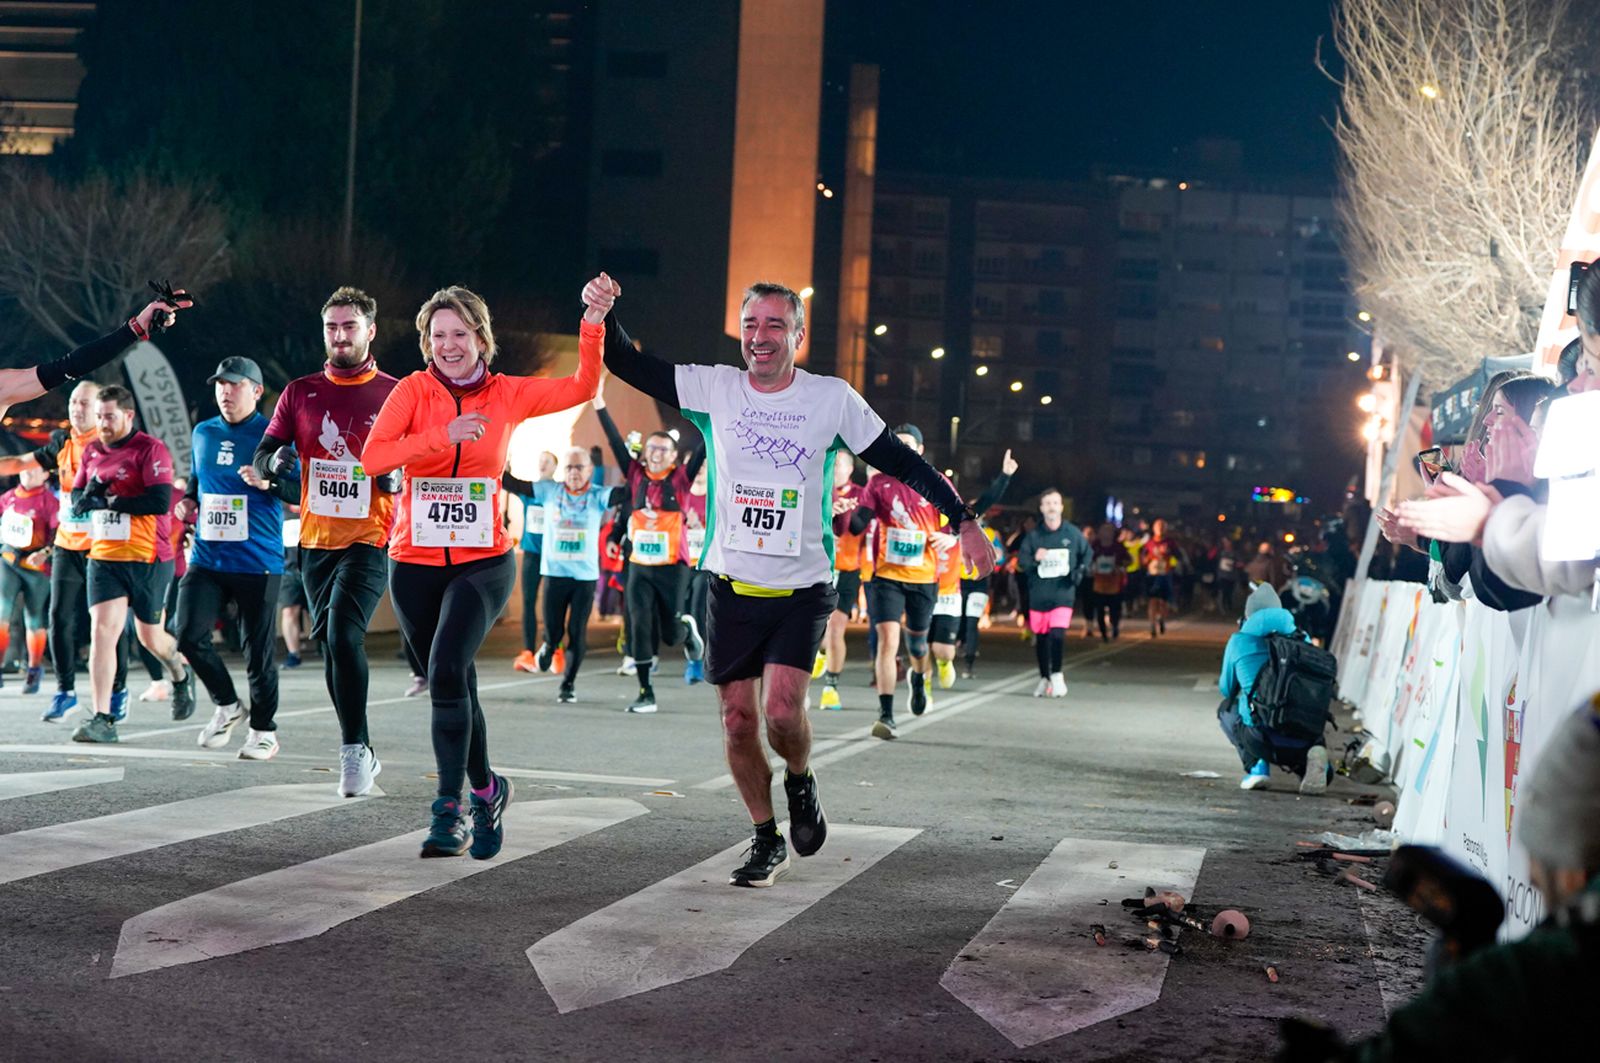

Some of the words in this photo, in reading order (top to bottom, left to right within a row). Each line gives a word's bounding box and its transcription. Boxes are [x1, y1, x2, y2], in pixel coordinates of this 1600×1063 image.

[331, 441, 345, 457] 43
[315, 471, 327, 479] SAN
[320, 480, 359, 499] 6404
[430, 485, 453, 493] NOCHE
[454, 485, 464, 493] DE
[743, 489, 764, 497] NOCHE
[765, 490, 775, 498] DE
[420, 493, 436, 501] SAN
[735, 496, 748, 504] SAN
[207, 511, 237, 525] 3075
[428, 502, 477, 523] 4759
[742, 507, 786, 530] 4757
[893, 541, 918, 553] 8291
